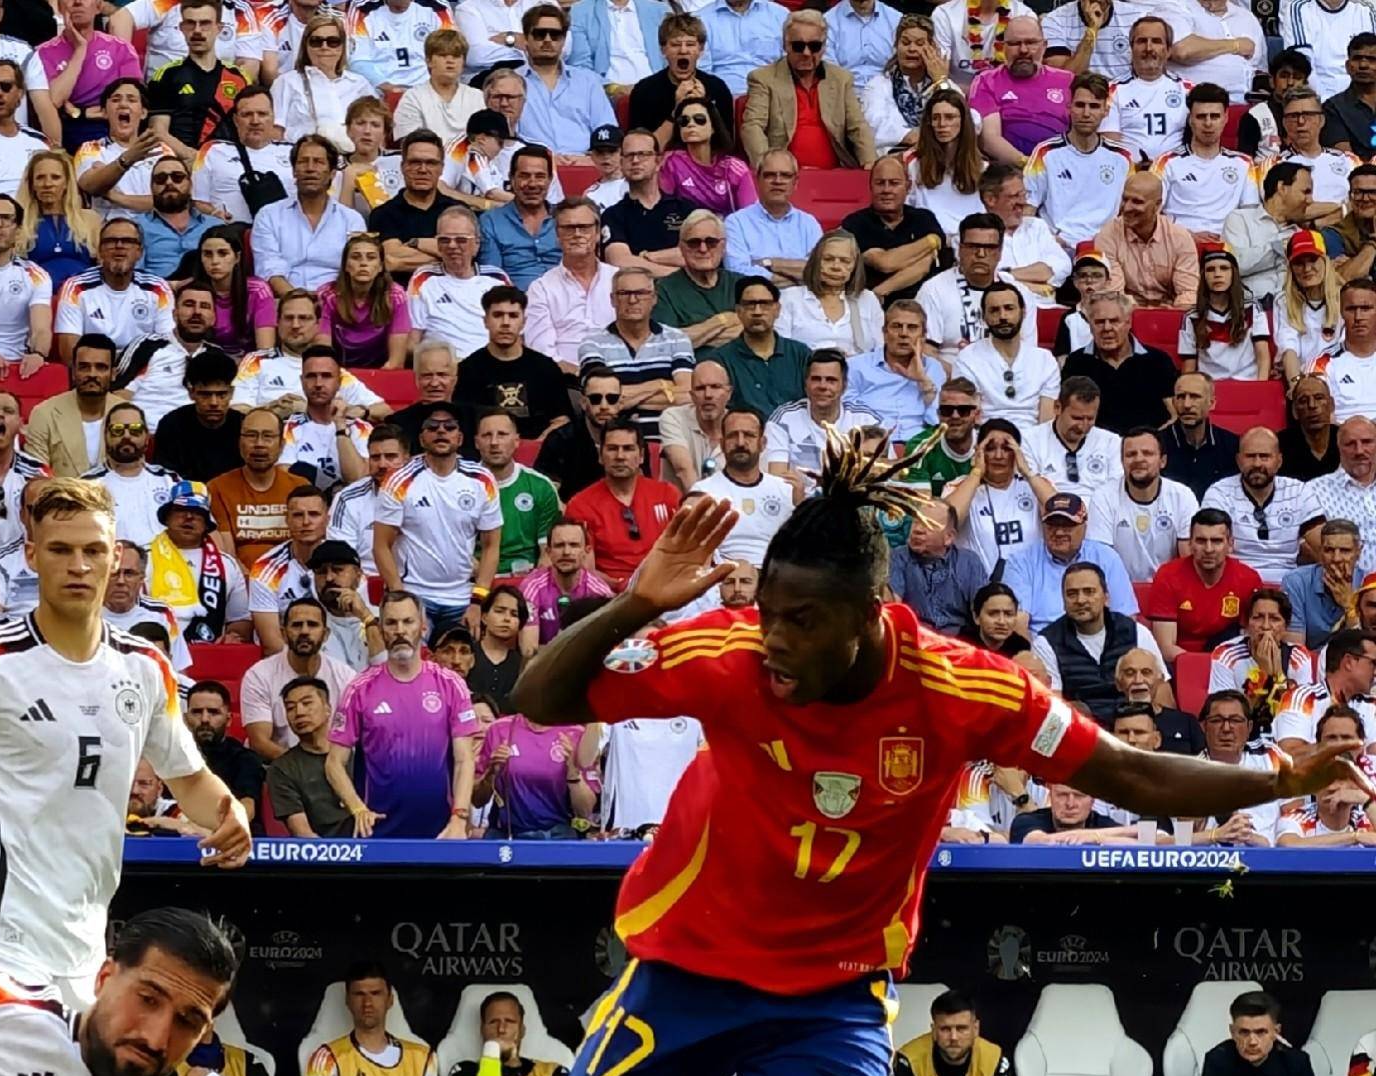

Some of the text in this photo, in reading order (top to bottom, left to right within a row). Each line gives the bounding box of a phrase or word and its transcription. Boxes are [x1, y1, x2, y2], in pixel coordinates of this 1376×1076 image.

[396, 47, 410, 67] 9
[1144, 113, 1166, 136] 13
[75, 735, 101, 789] 6
[790, 820, 861, 883] 17
[391, 922, 523, 959] QATAR
[1174, 927, 1303, 964] QATAR
[421, 956, 523, 976] AIRWAYS
[1204, 961, 1304, 982] AIRWAYS
